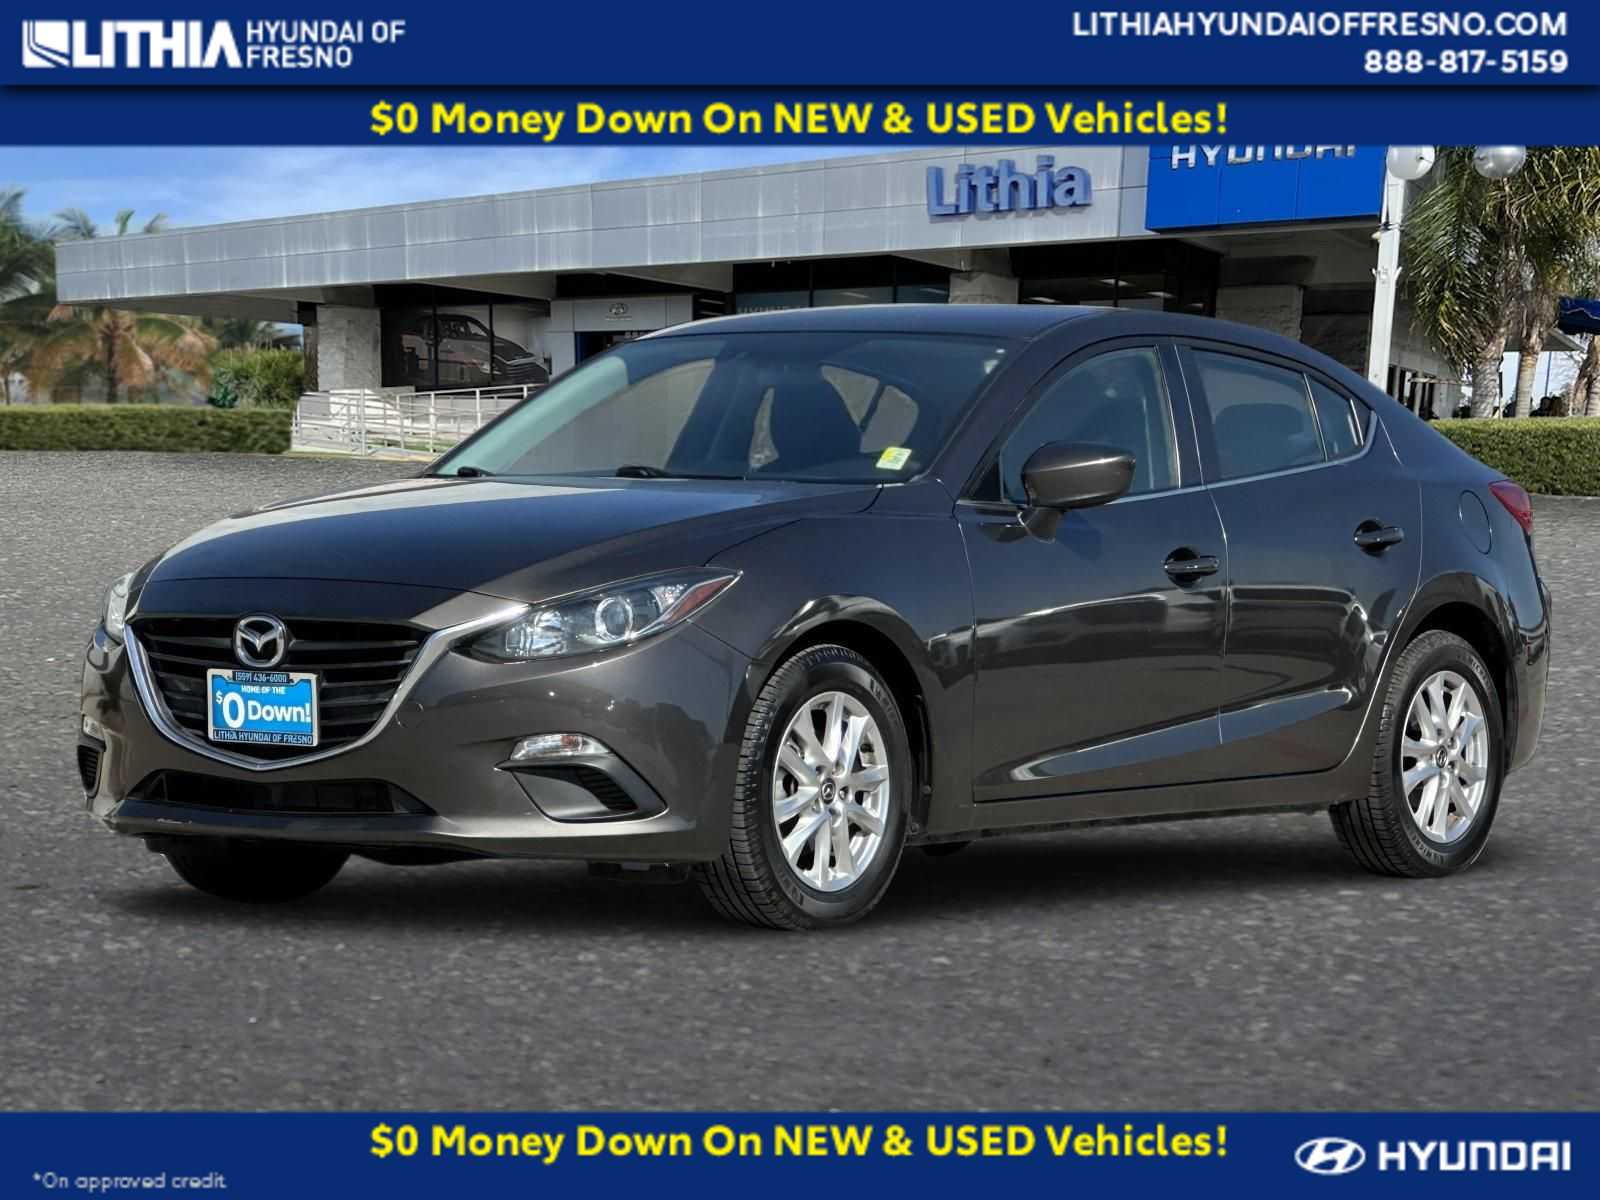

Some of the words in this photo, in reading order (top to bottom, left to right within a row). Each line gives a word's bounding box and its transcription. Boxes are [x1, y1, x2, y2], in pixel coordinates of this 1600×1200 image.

[927, 155, 1093, 217] Lithia
[241, 685, 260, 694] HOME
[271, 686, 286, 695] THE
[247, 700, 312, 723] Down!
[214, 730, 238, 740] LITHIA
[239, 732, 271, 743] HYUNDAI
[272, 734, 282, 743] OF
[283, 735, 312, 745] FRESNO
